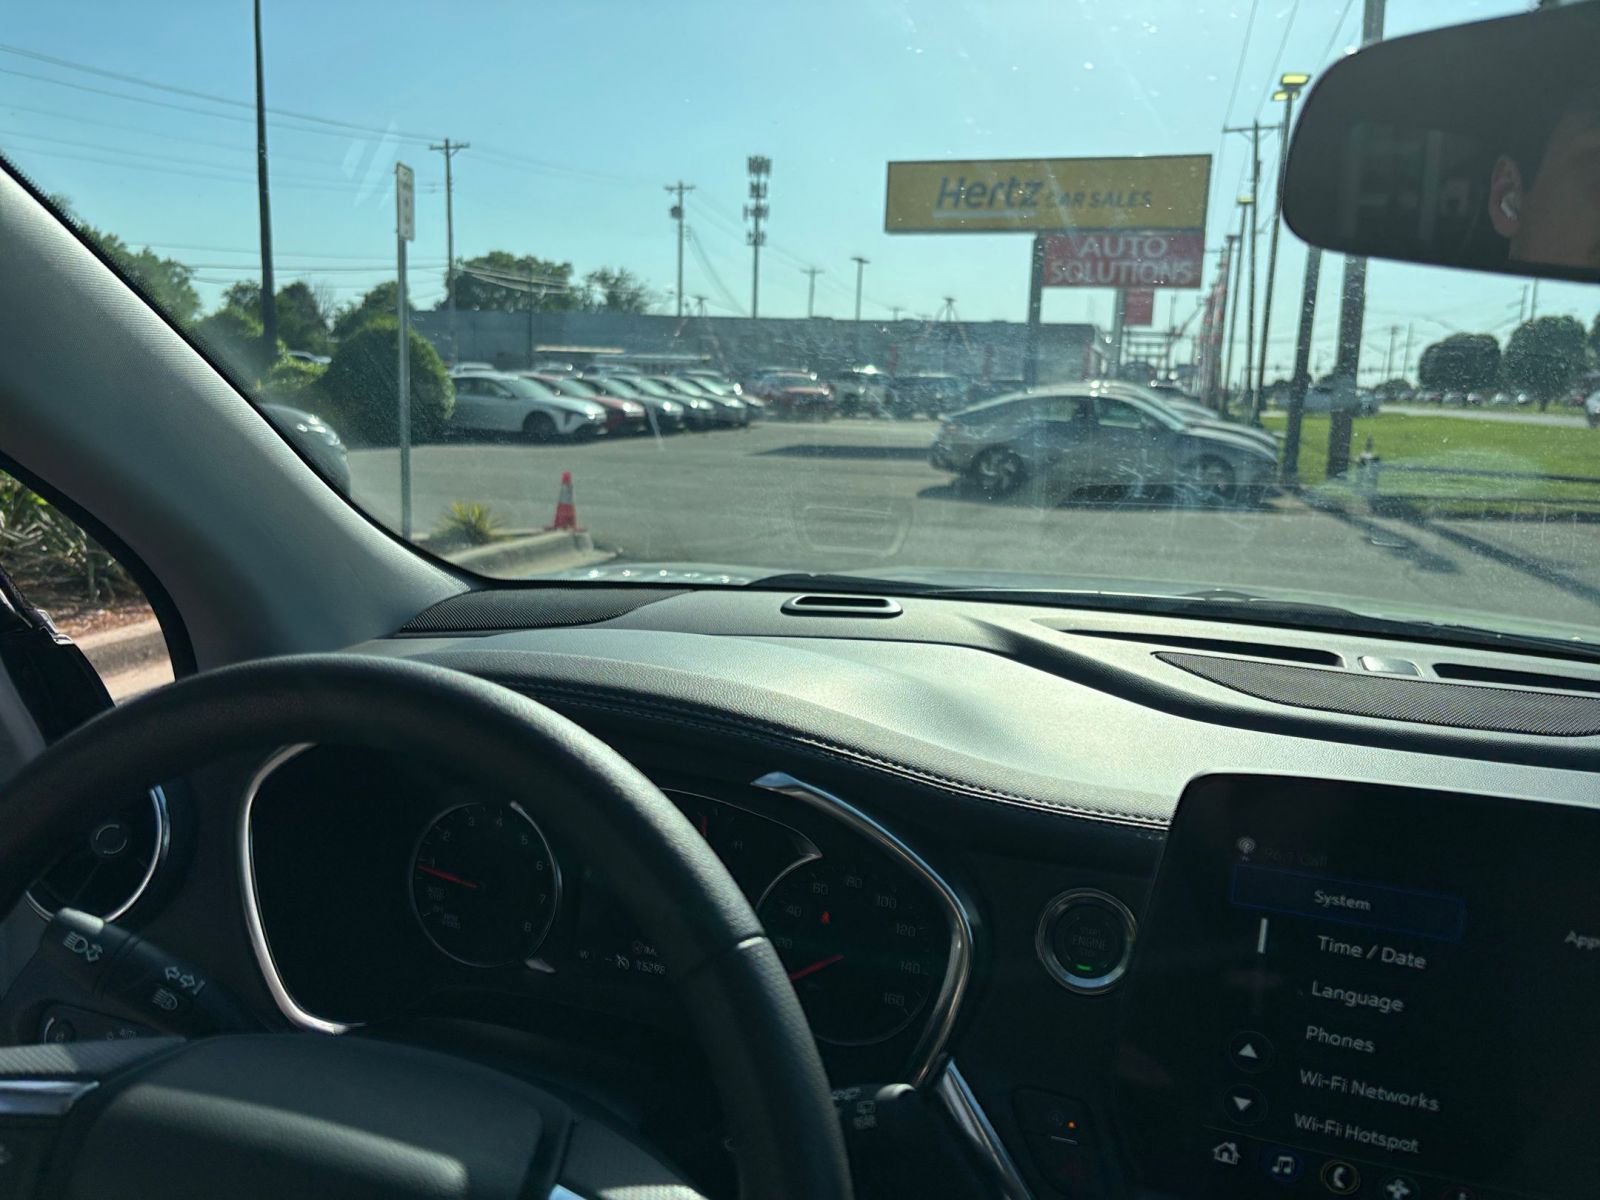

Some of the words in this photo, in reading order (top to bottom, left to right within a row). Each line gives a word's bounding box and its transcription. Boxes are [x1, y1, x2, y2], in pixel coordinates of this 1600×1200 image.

[936, 176, 1044, 209] Hertz
[1088, 190, 1152, 209] SALES
[1078, 236, 1168, 258] AUTO
[1051, 259, 1193, 284] SOLUTIONS
[536, 860, 544, 871] 6
[846, 876, 862, 889] 80
[785, 903, 801, 917] 40
[877, 896, 896, 908] 100
[1313, 889, 1371, 911] System
[1317, 935, 1363, 958] Time
[1366, 944, 1379, 960] /
[1381, 946, 1427, 970] Date
[900, 961, 921, 975] 140
[884, 992, 905, 1007] 160
[1311, 979, 1404, 1014] Language
[1305, 1025, 1376, 1053] Phones
[1300, 1067, 1348, 1093] Wi-Fi
[1351, 1079, 1440, 1112] Networks
[1294, 1112, 1342, 1137] Wi-Fi
[1345, 1122, 1420, 1153] Hotspot
